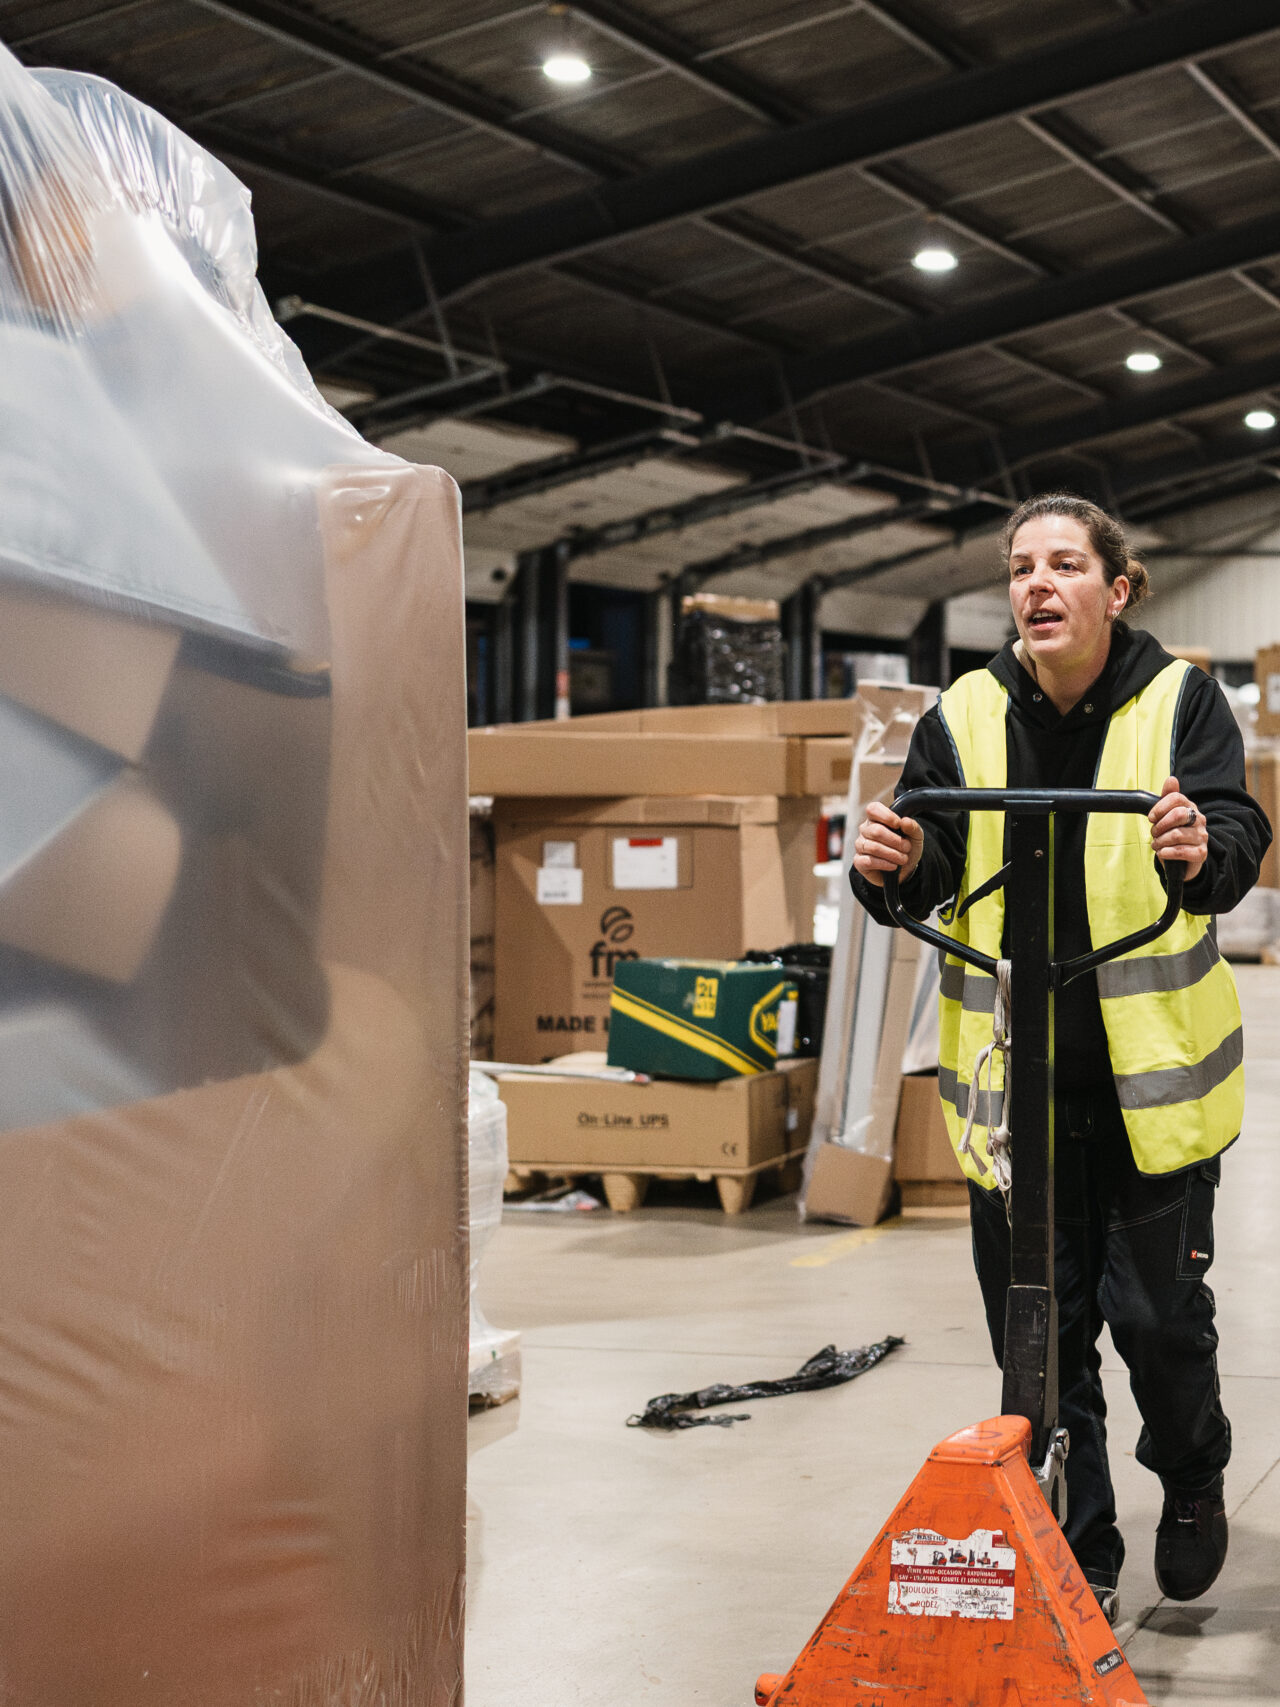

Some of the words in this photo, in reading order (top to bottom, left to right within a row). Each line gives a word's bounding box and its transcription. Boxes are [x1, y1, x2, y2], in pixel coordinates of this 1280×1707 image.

[537, 1016, 596, 1032] MADE
[640, 1113, 669, 1127] UPS
[907, 1567, 921, 1575] VENTE
